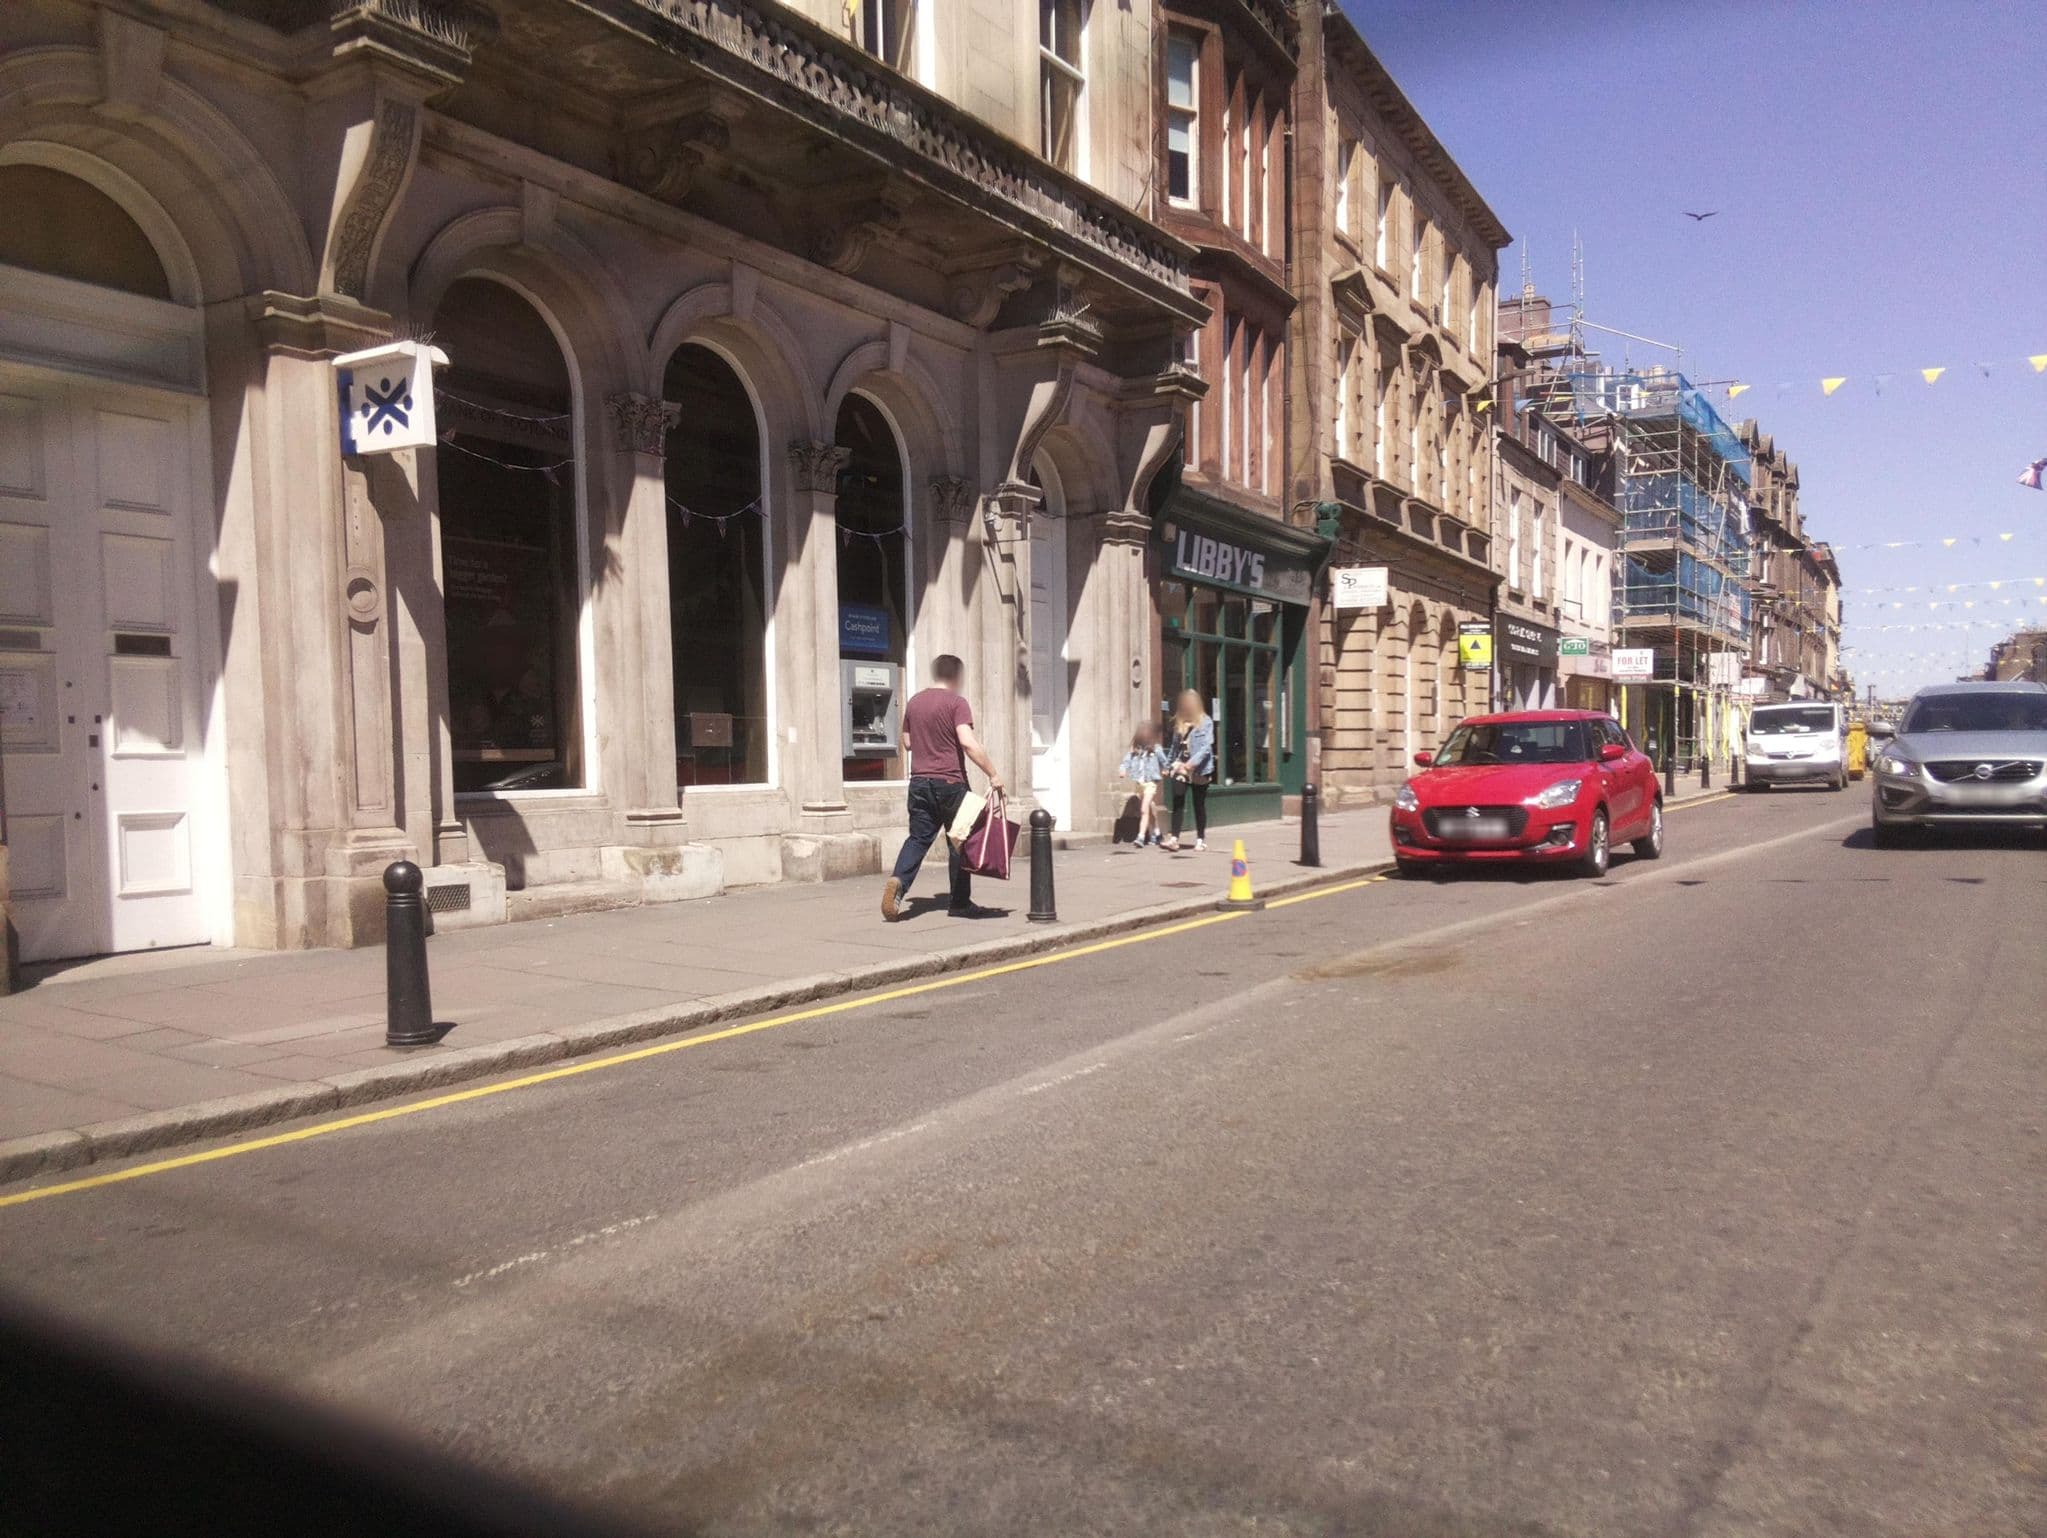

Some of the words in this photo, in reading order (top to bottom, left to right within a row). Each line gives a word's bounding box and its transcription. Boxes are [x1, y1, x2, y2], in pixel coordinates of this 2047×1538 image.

[1176, 530, 1265, 588] LIBBY'S
[845, 621, 880, 635] Cashpoint
[1617, 656, 1633, 665] FOR
[1635, 656, 1648, 665] LET
